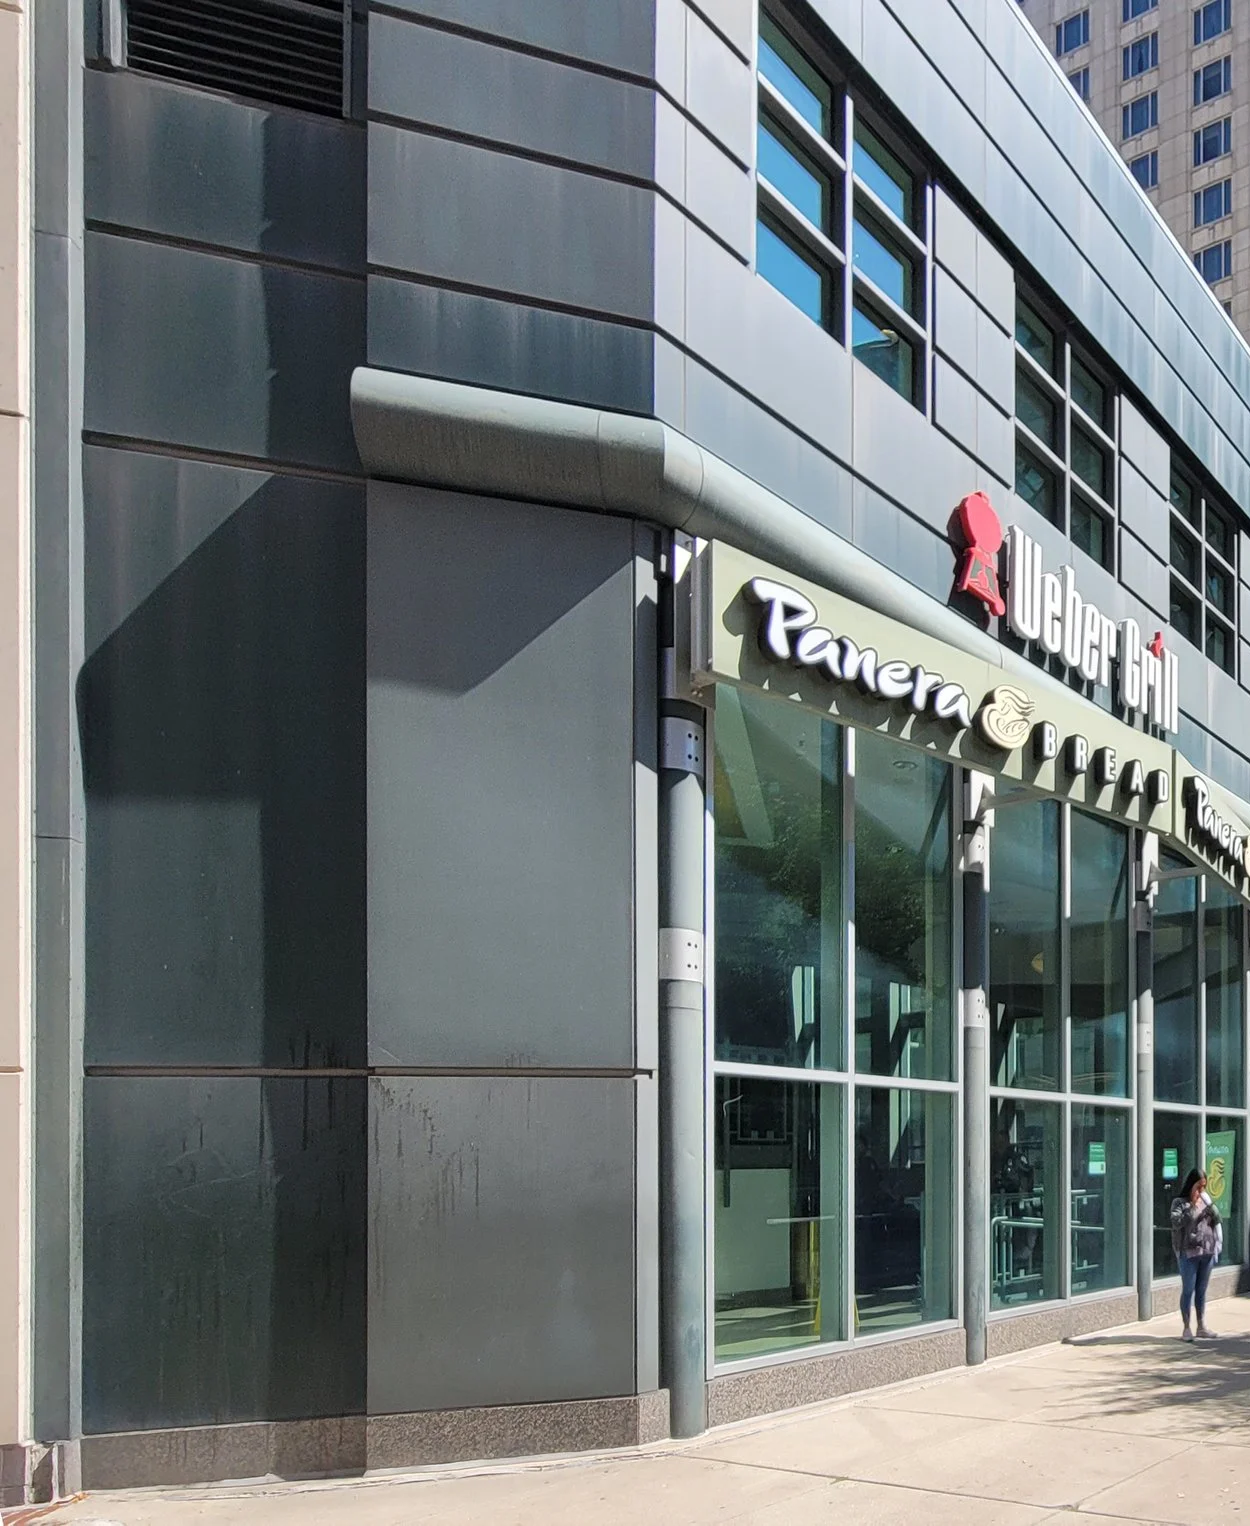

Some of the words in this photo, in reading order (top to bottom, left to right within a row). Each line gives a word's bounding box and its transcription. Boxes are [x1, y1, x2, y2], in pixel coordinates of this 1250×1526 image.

[752, 577, 972, 729] Panera
[1040, 720, 1169, 803] BREAD
[1007, 525, 1118, 688] Weber
[1117, 617, 1179, 735] Grill
[1193, 775, 1244, 866] Panera
